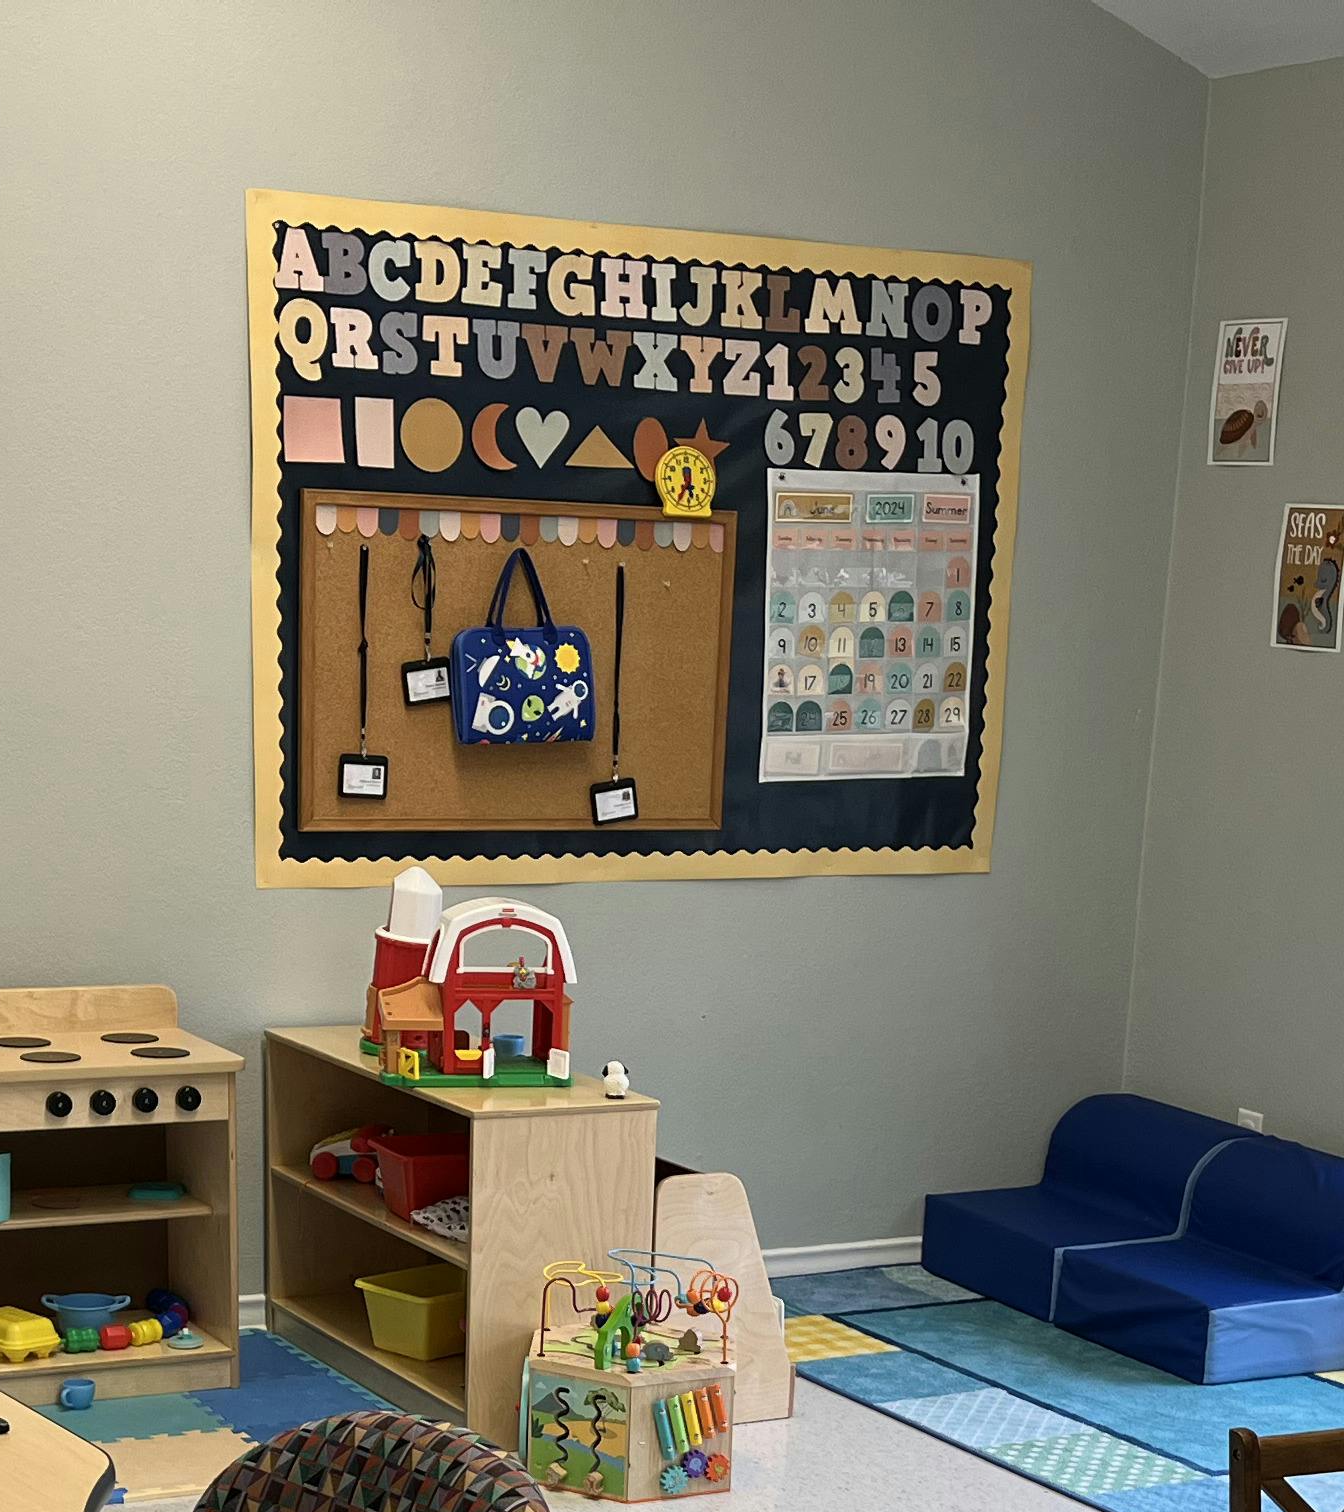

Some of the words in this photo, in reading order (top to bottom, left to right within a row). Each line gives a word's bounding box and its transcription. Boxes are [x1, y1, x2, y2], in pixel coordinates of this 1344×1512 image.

[1224, 326, 1275, 367] NEVER
[1223, 359, 1244, 375] GIVE
[810, 501, 836, 516] June
[875, 501, 906, 516] 2024
[925, 501, 968, 516] Summer
[1289, 512, 1326, 539] SEAS
[1286, 543, 1303, 565] THE
[1304, 543, 1324, 566] DAY
[778, 601, 787, 618] 2
[807, 603, 817, 619] 3
[868, 601, 878, 618] 5
[925, 601, 934, 617] 7
[955, 600, 963, 616] 8
[778, 638, 786, 654] 9
[804, 636, 818, 652] 10
[837, 637, 847, 653] 11
[894, 637, 907, 653] 13
[922, 637, 934, 652] 14
[950, 636, 961, 652] 15
[804, 675, 817, 691] 17
[863, 673, 876, 691] 19
[890, 673, 910, 690] 20
[922, 673, 933, 689] 21
[948, 672, 962, 687] 22
[832, 711, 848, 727] 25
[861, 709, 877, 725] 26
[890, 709, 908, 725] 27
[917, 708, 930, 725] 28
[944, 707, 961, 723] 29
